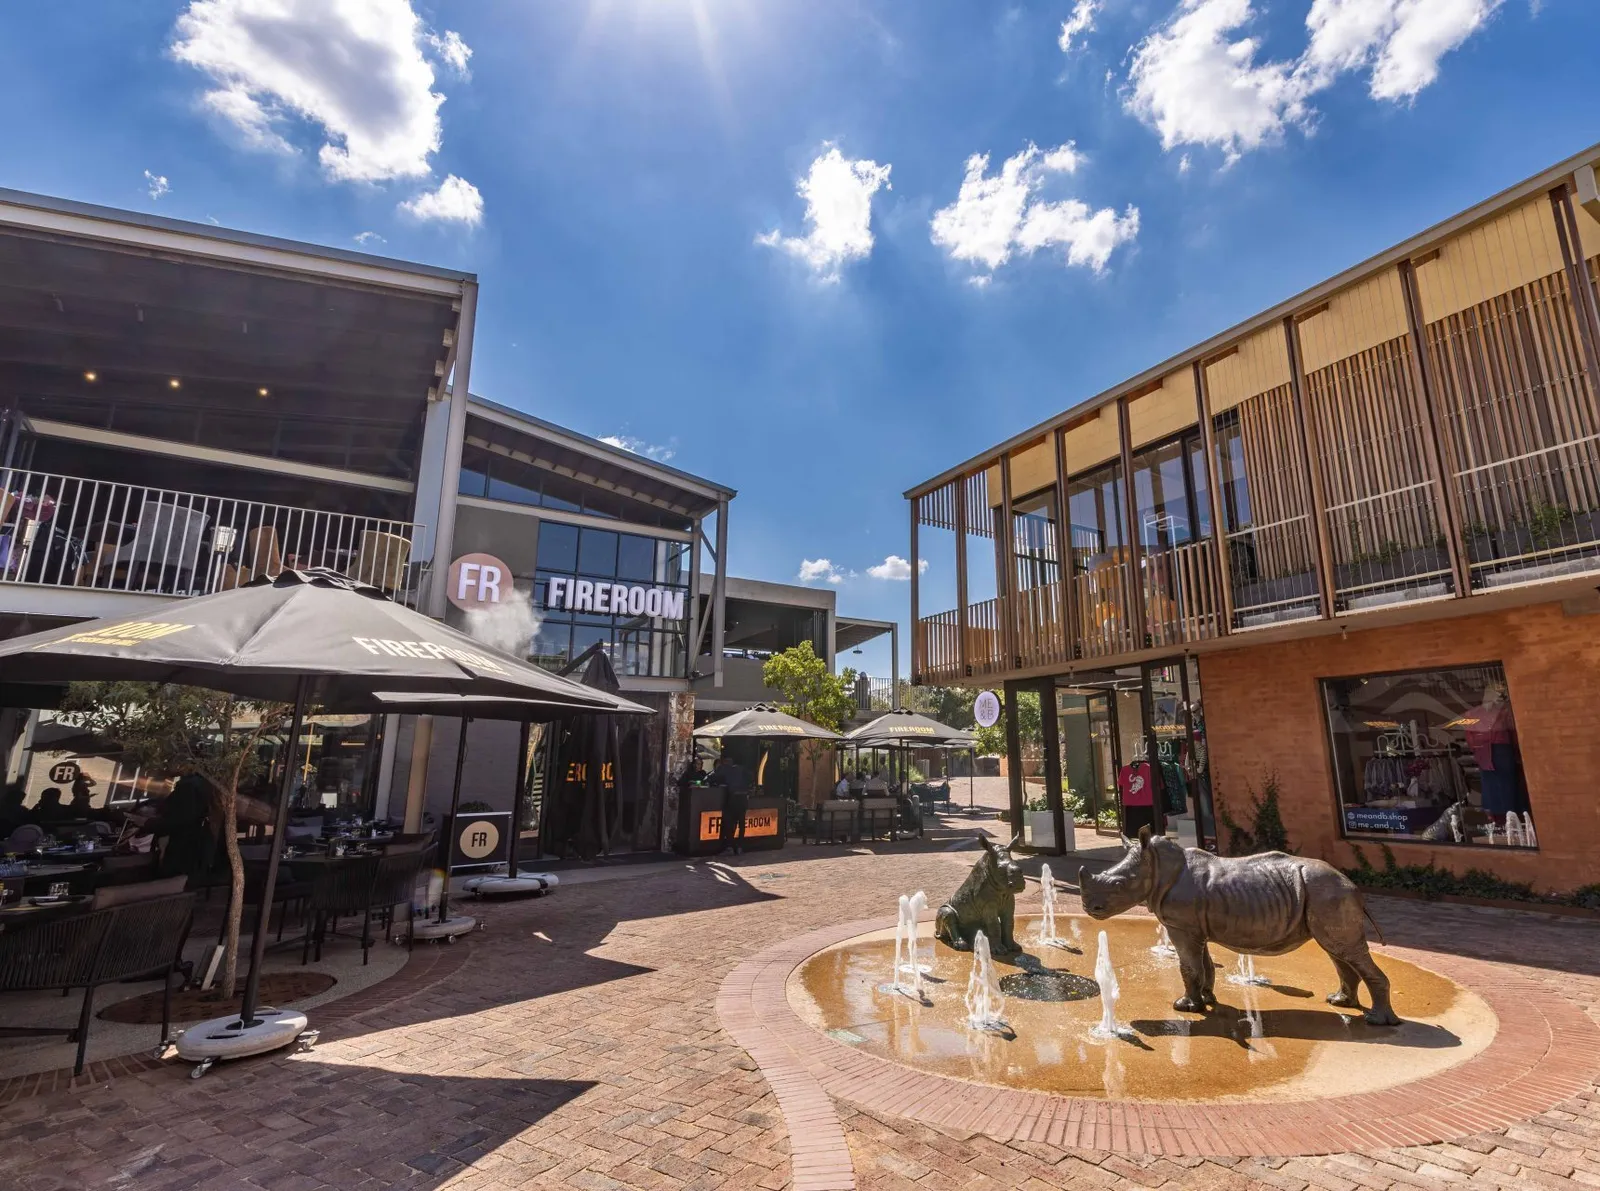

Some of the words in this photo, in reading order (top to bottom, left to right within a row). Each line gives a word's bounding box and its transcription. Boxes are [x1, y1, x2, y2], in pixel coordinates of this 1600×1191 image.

[457, 563, 501, 602] FR
[547, 577, 684, 620] FIREROOM
[980, 698, 993, 709] ME
[53, 766, 75, 780] FR
[471, 832, 487, 847] FR
